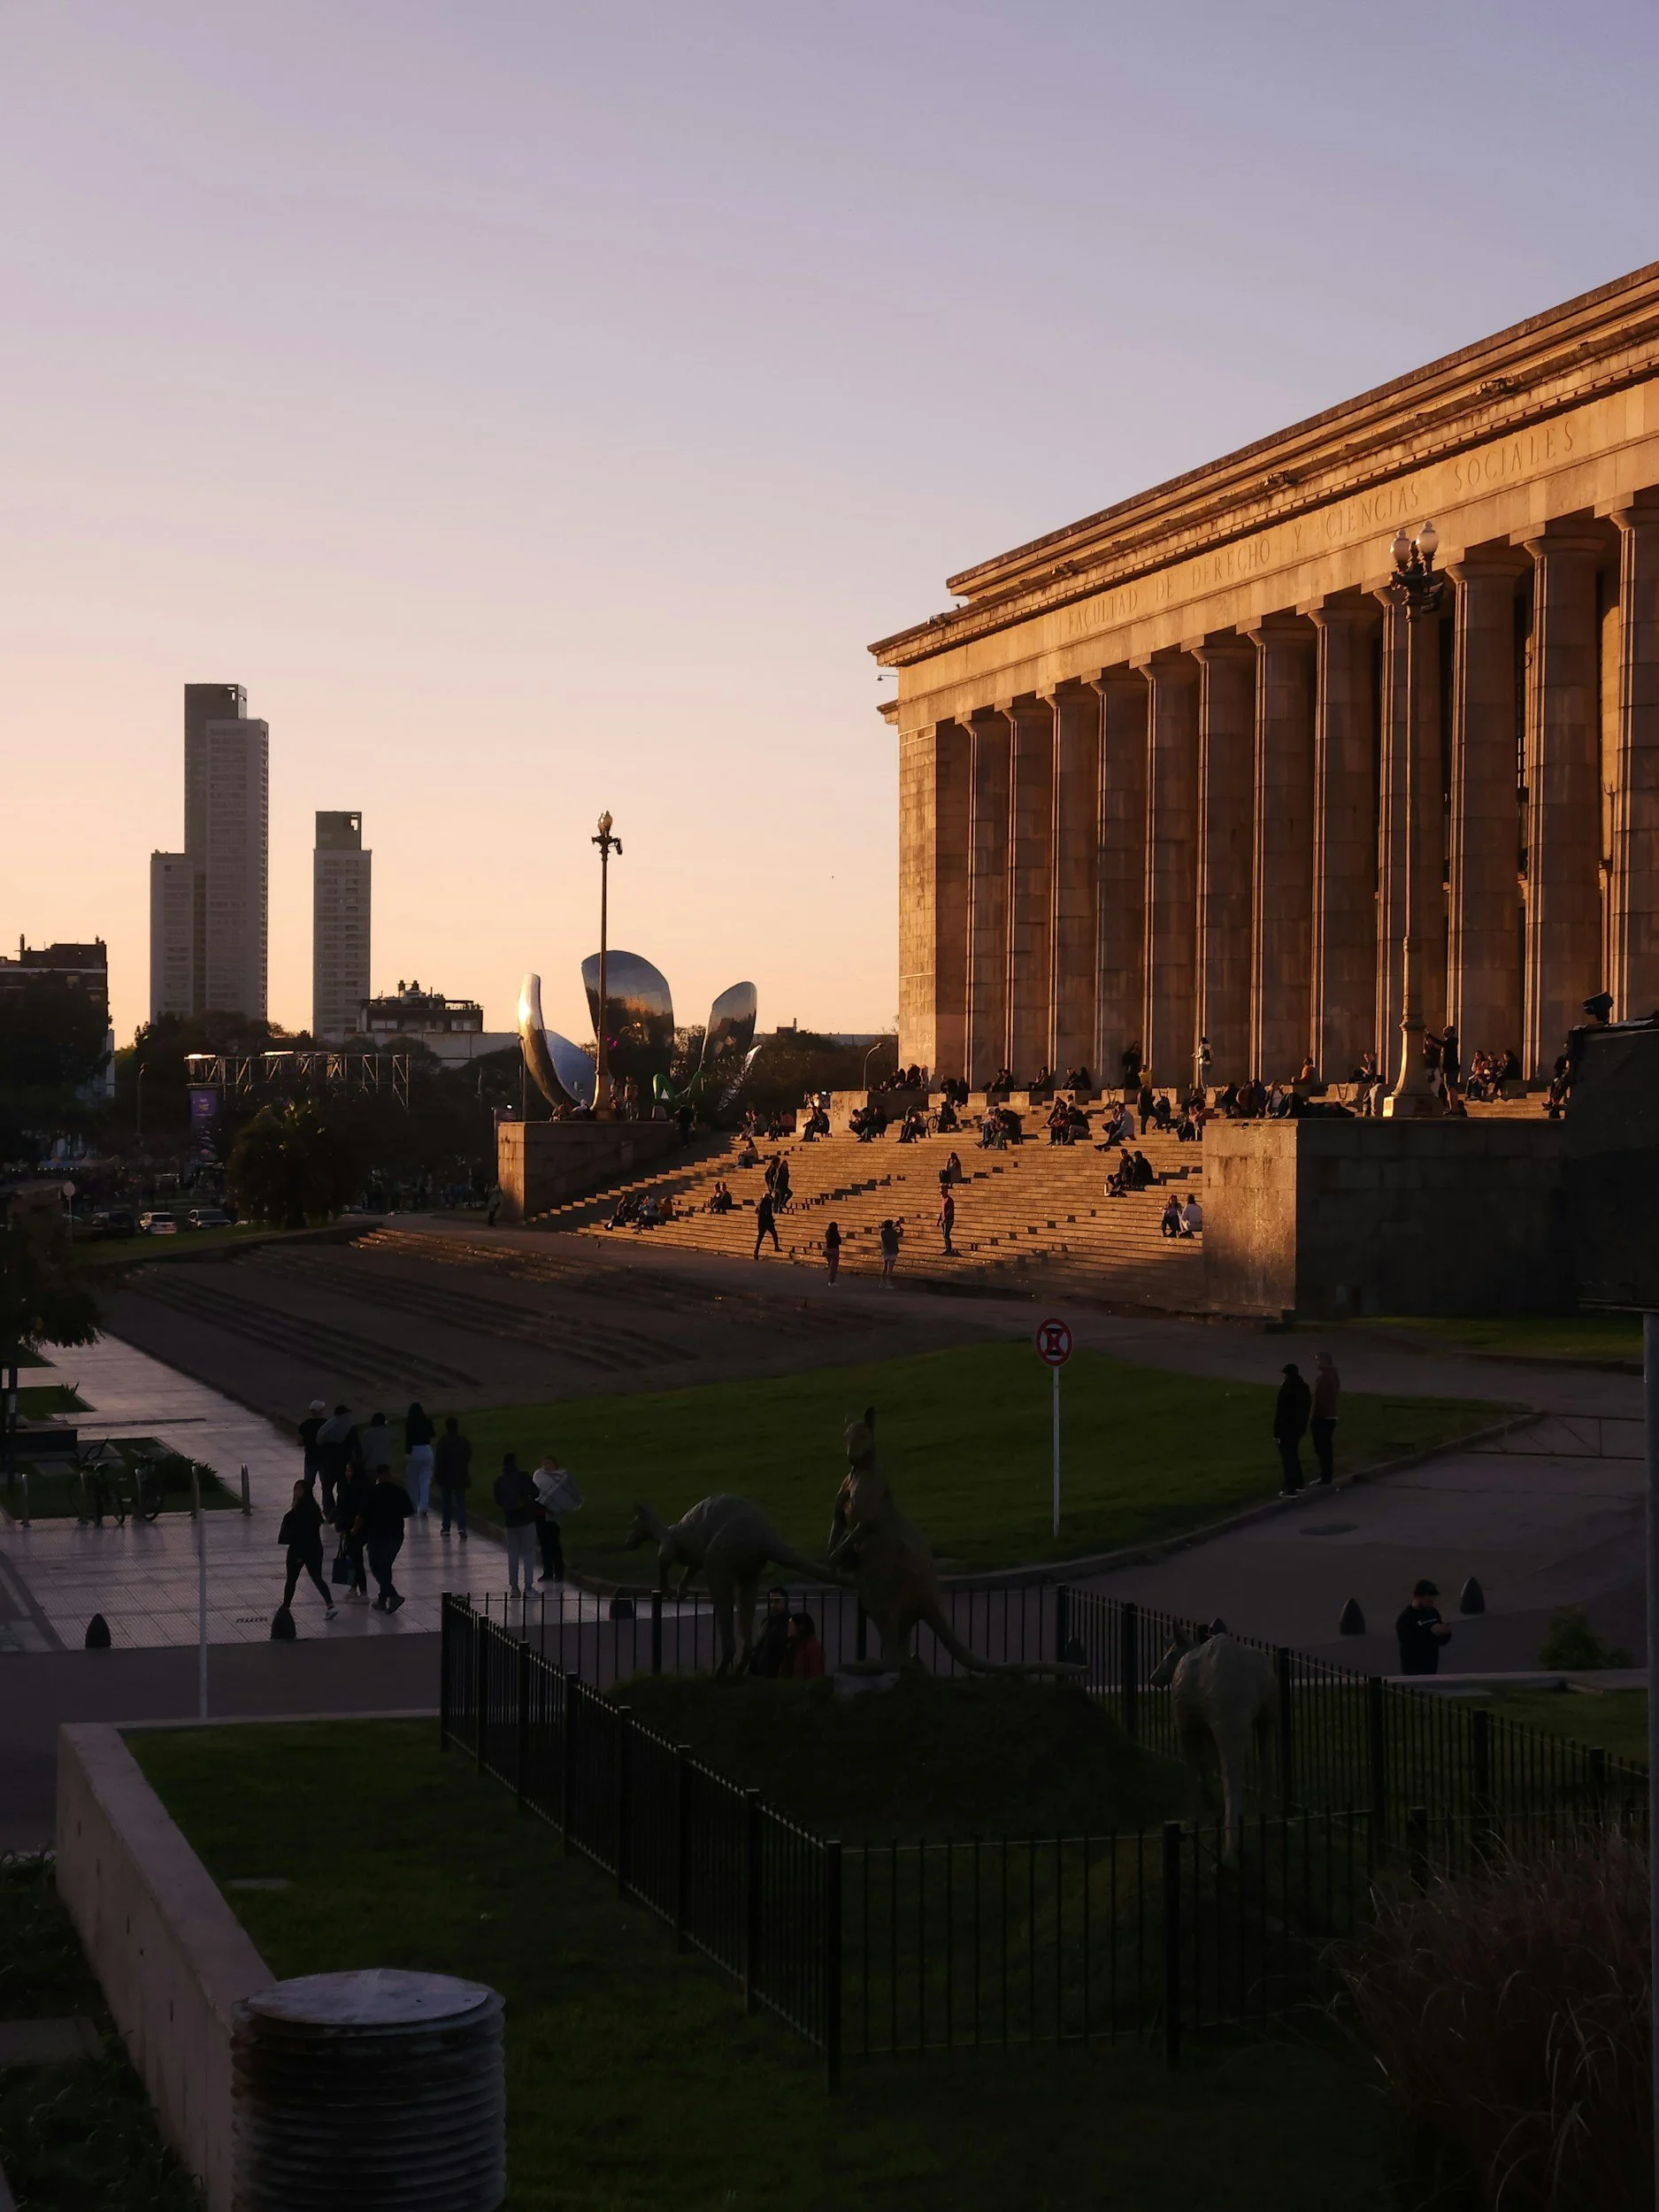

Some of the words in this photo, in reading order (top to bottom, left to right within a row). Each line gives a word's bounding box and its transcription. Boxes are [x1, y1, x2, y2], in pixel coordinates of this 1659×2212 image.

[1068, 588, 1138, 635] FACULTAD
[1156, 573, 1175, 603] DE
[1192, 537, 1271, 591] DERECHO
[1294, 524, 1302, 553] Y
[1325, 480, 1418, 540] CIENCIAS
[1455, 419, 1573, 492] SOCIALES
